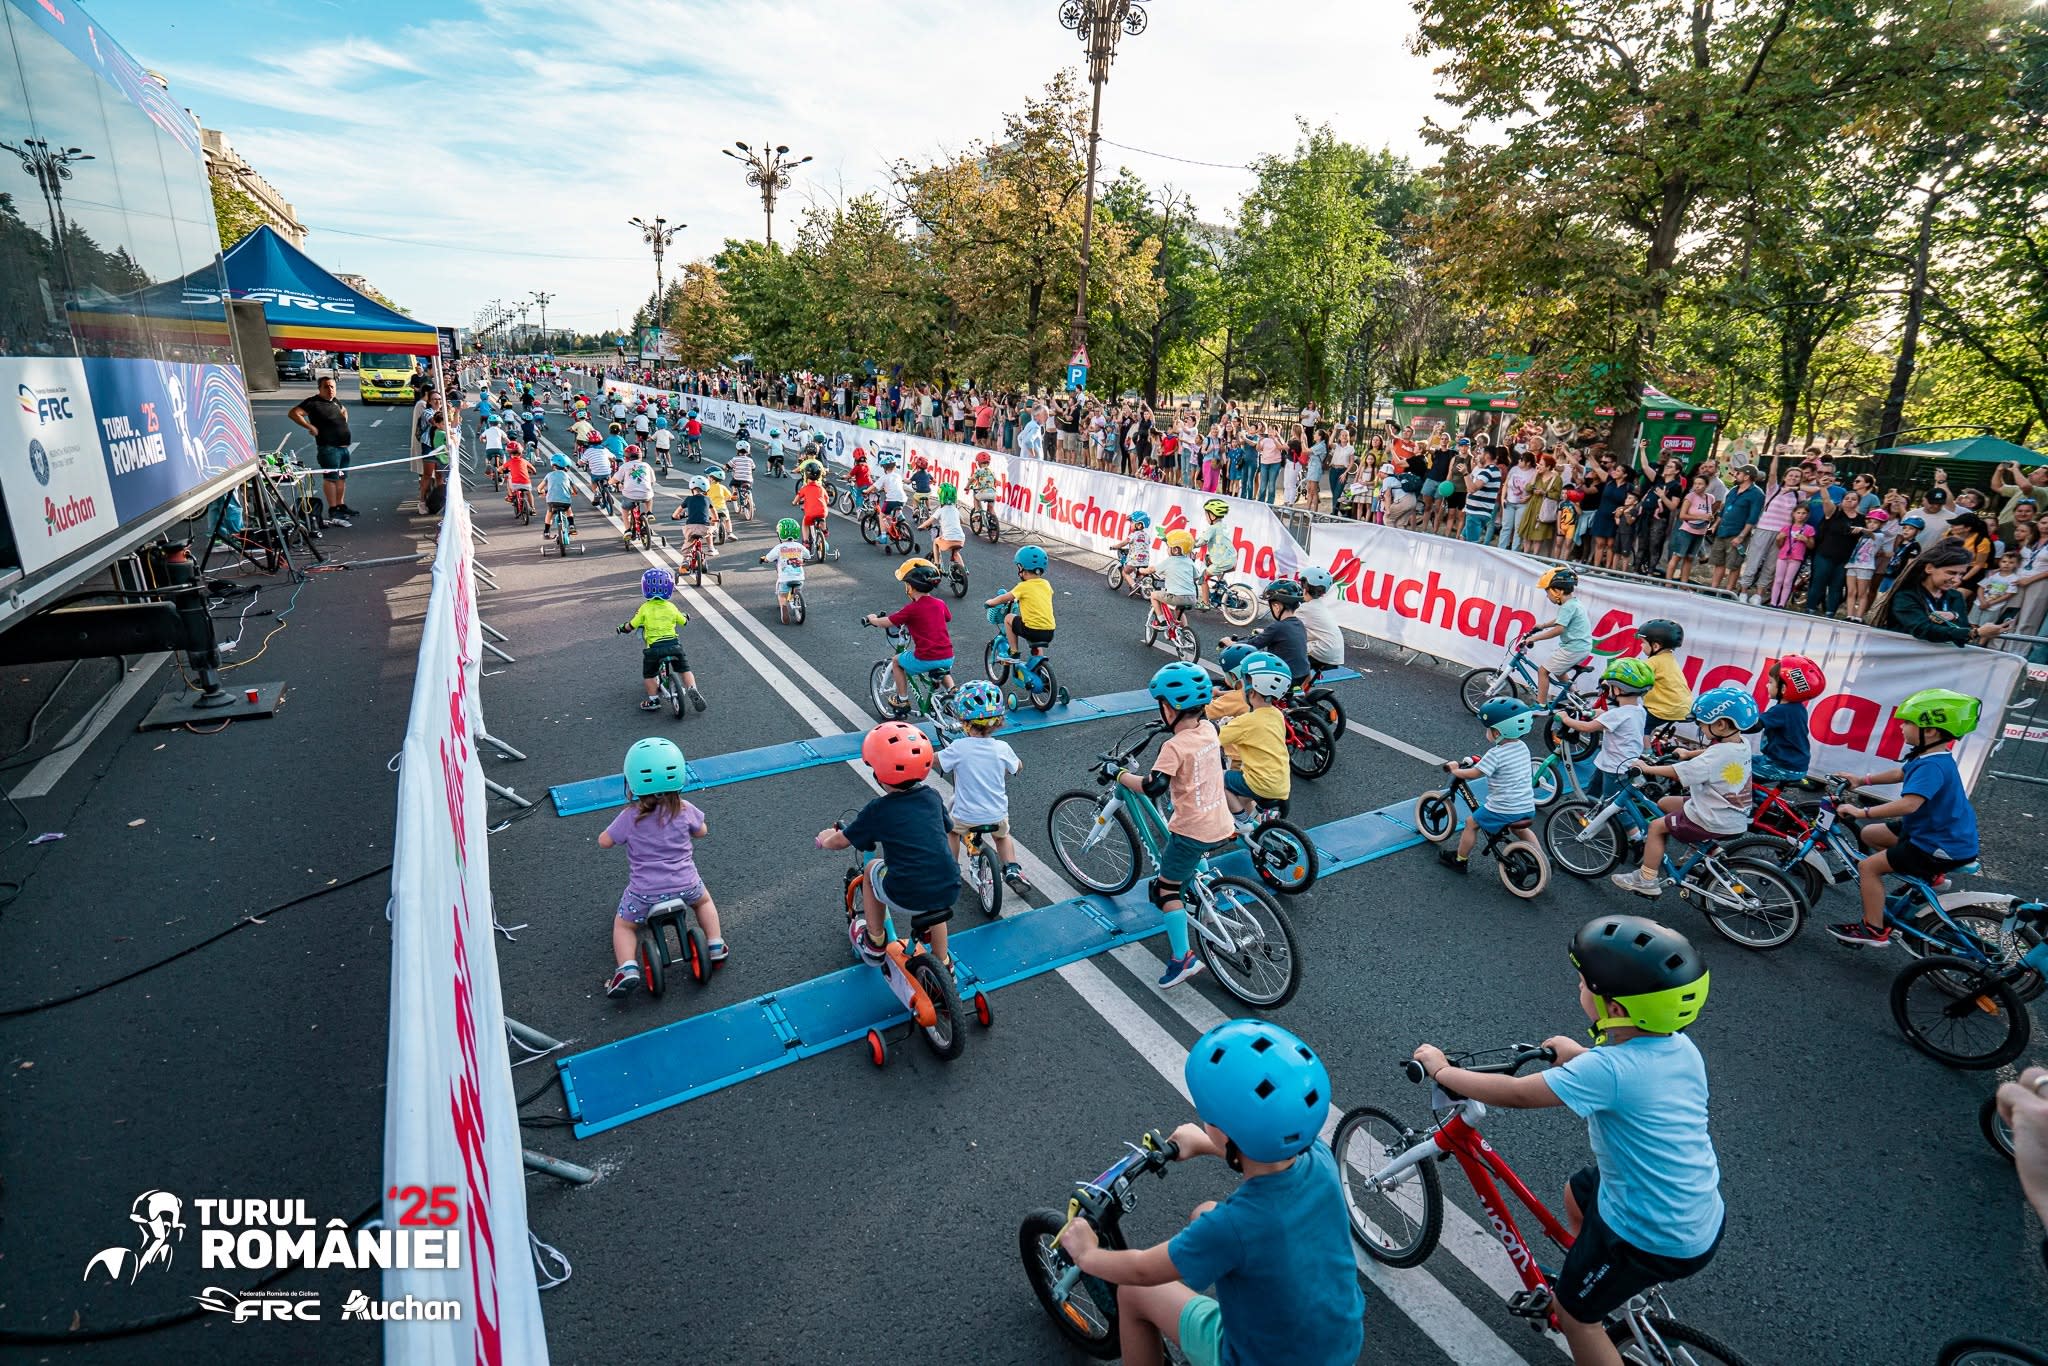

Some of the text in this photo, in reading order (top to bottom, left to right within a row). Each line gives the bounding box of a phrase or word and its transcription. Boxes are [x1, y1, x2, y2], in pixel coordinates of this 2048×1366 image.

[241, 292, 355, 314] FRC
[1071, 368, 1082, 383] P
[38, 396, 73, 422] FRC
[102, 415, 133, 440] TURUL
[109, 428, 166, 476] ROMÂNIEI
[45, 494, 97, 537] Auchan
[1328, 548, 1538, 653] Auchan
[1790, 668, 1810, 693] IGNITE
[1703, 699, 1736, 720] woom
[1917, 708, 1947, 726] 45
